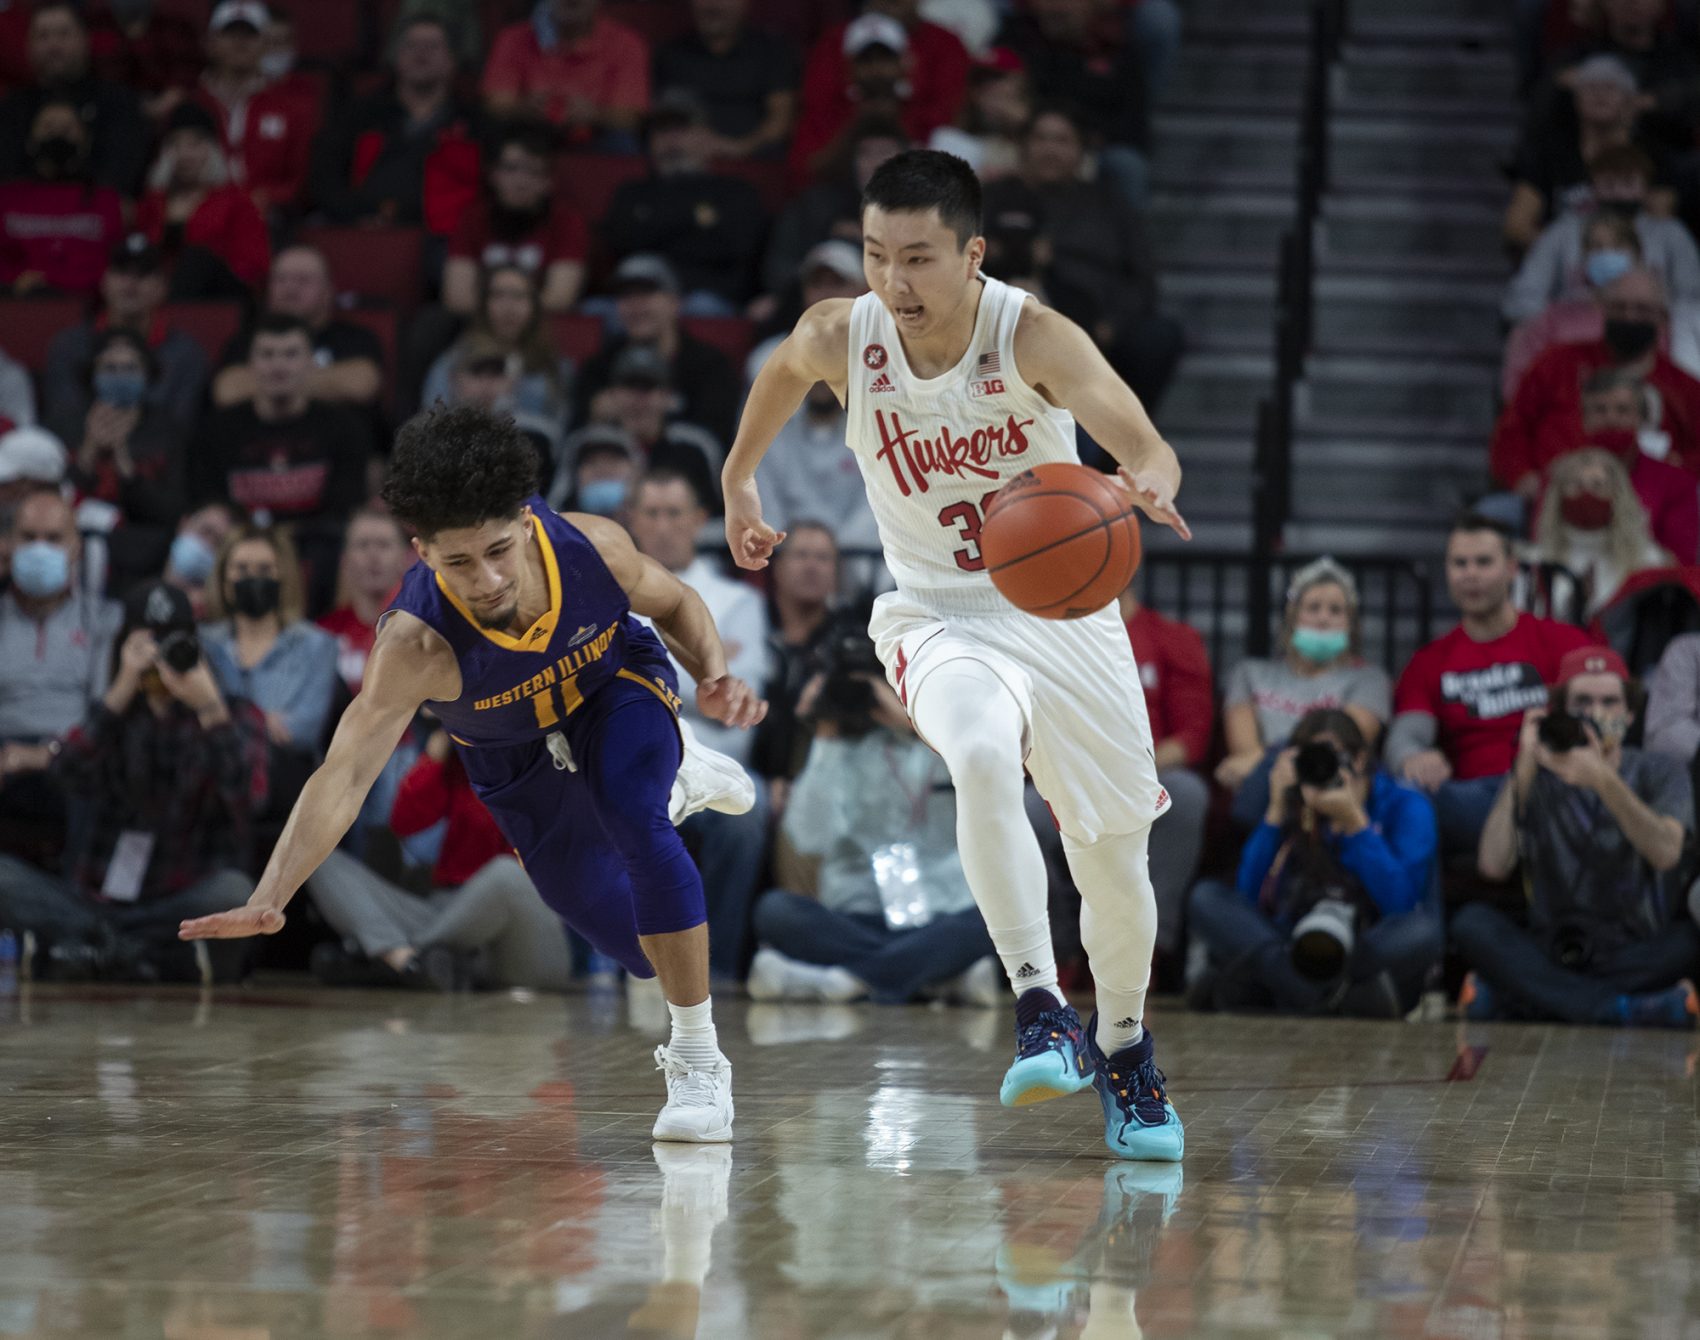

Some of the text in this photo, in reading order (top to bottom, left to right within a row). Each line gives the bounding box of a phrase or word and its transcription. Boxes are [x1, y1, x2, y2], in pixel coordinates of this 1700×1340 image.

[875, 409, 1034, 497] Huskers
[937, 489, 1000, 572] 3
[474, 665, 556, 711] WESTERN
[532, 673, 584, 729] 11
